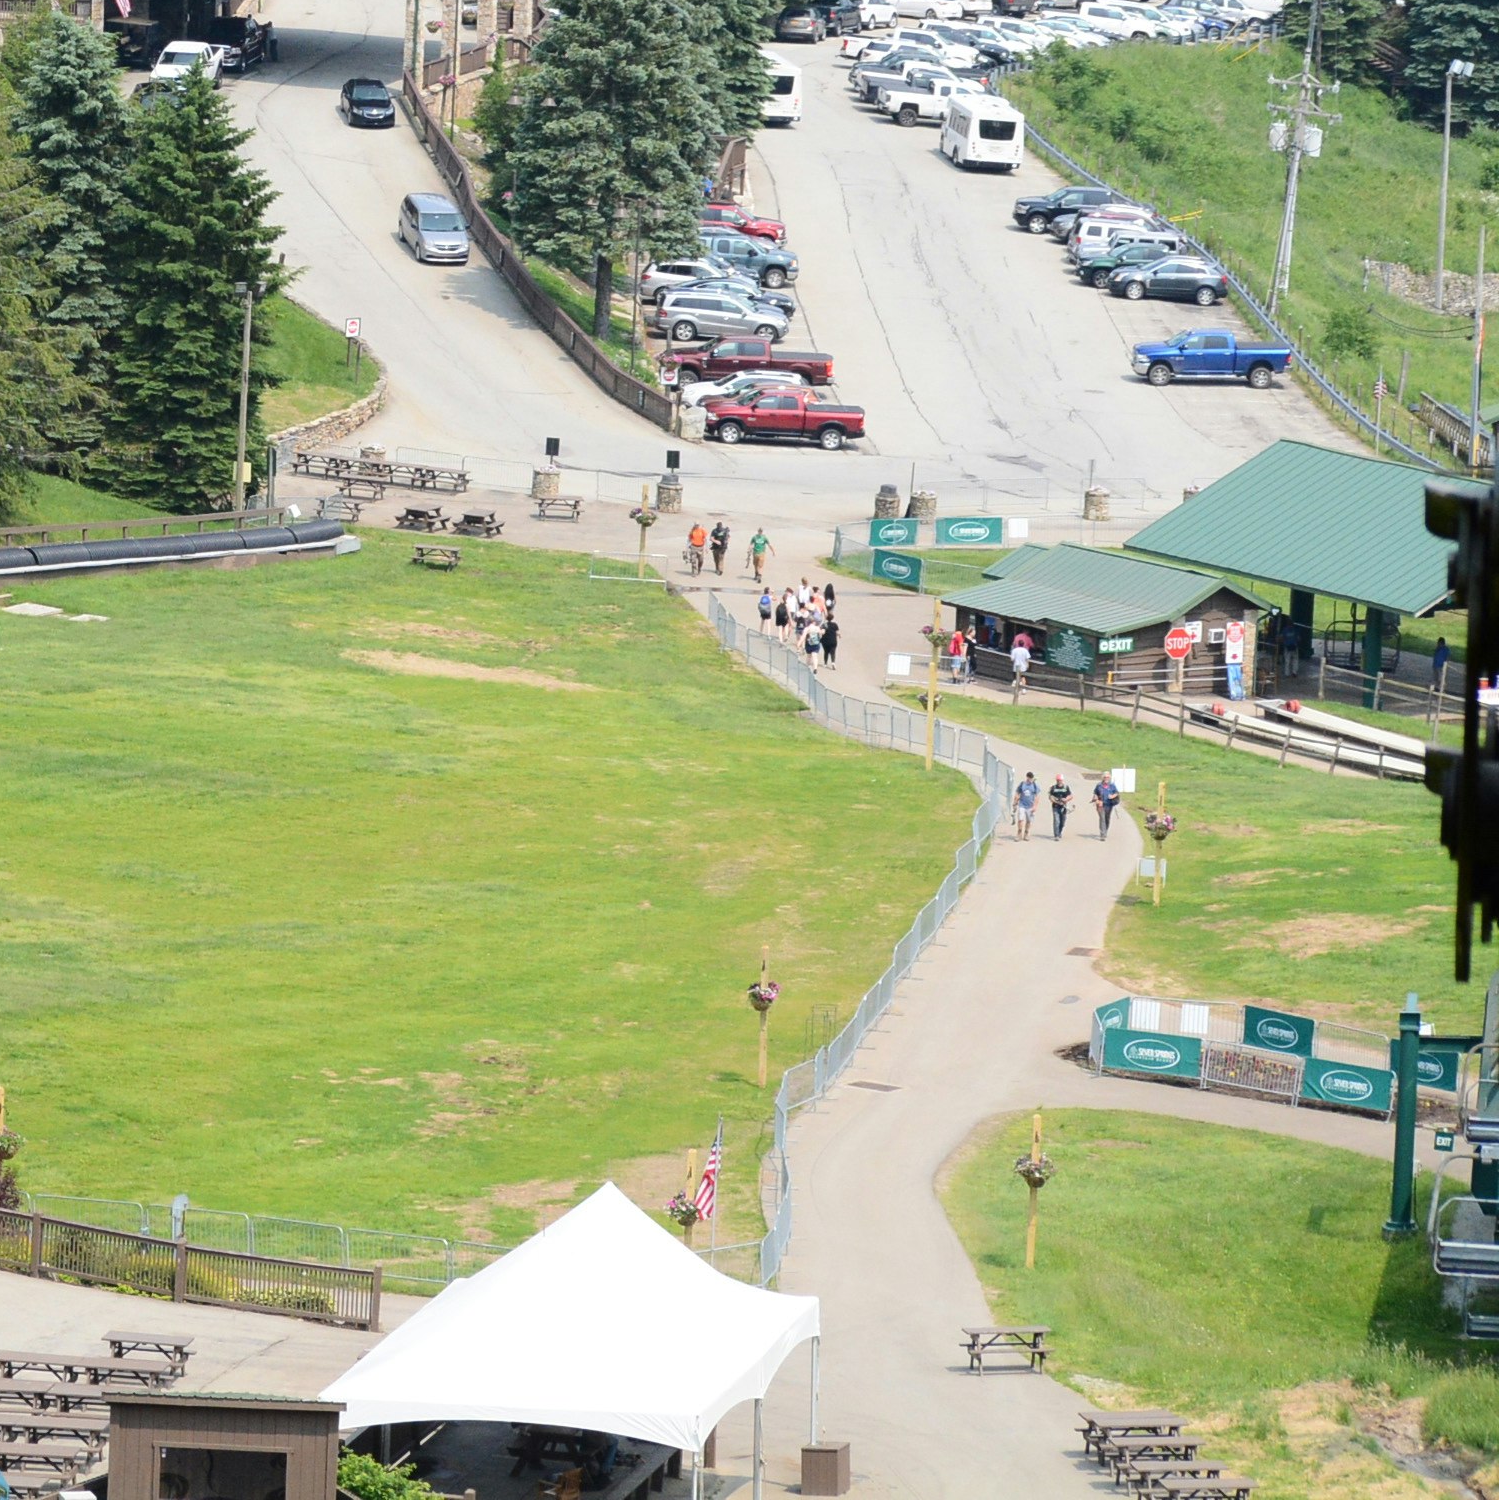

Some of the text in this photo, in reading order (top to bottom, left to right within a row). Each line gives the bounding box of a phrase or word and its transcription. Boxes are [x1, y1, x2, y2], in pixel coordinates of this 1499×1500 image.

[1108, 638, 1133, 652] EXIT
[1166, 637, 1190, 650] STOP
[1436, 1136, 1452, 1147] EXIT
